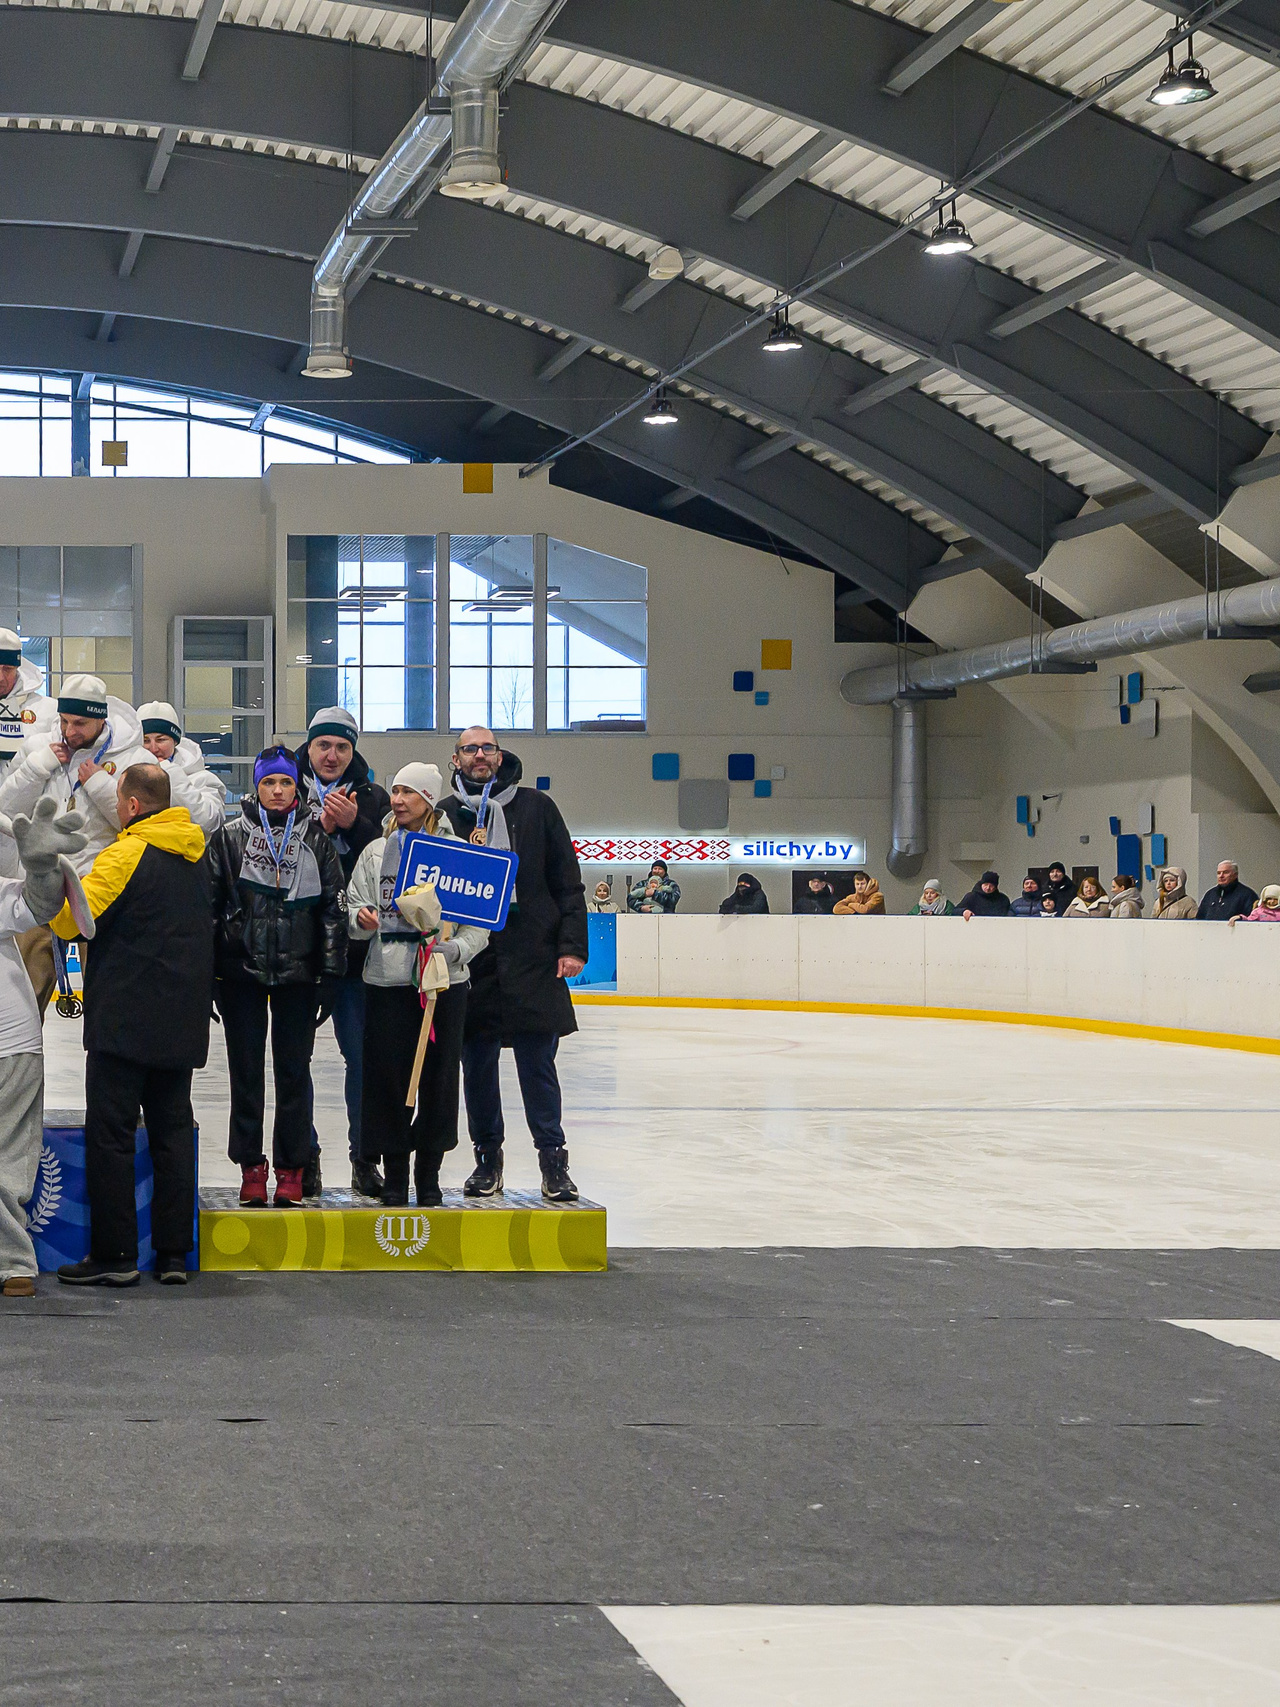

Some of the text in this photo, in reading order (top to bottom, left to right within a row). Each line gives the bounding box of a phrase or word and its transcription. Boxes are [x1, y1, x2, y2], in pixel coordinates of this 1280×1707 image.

[0, 722, 21, 733] ТИГРЫ
[743, 840, 853, 860] silichy.by
[414, 863, 495, 900] Единые
